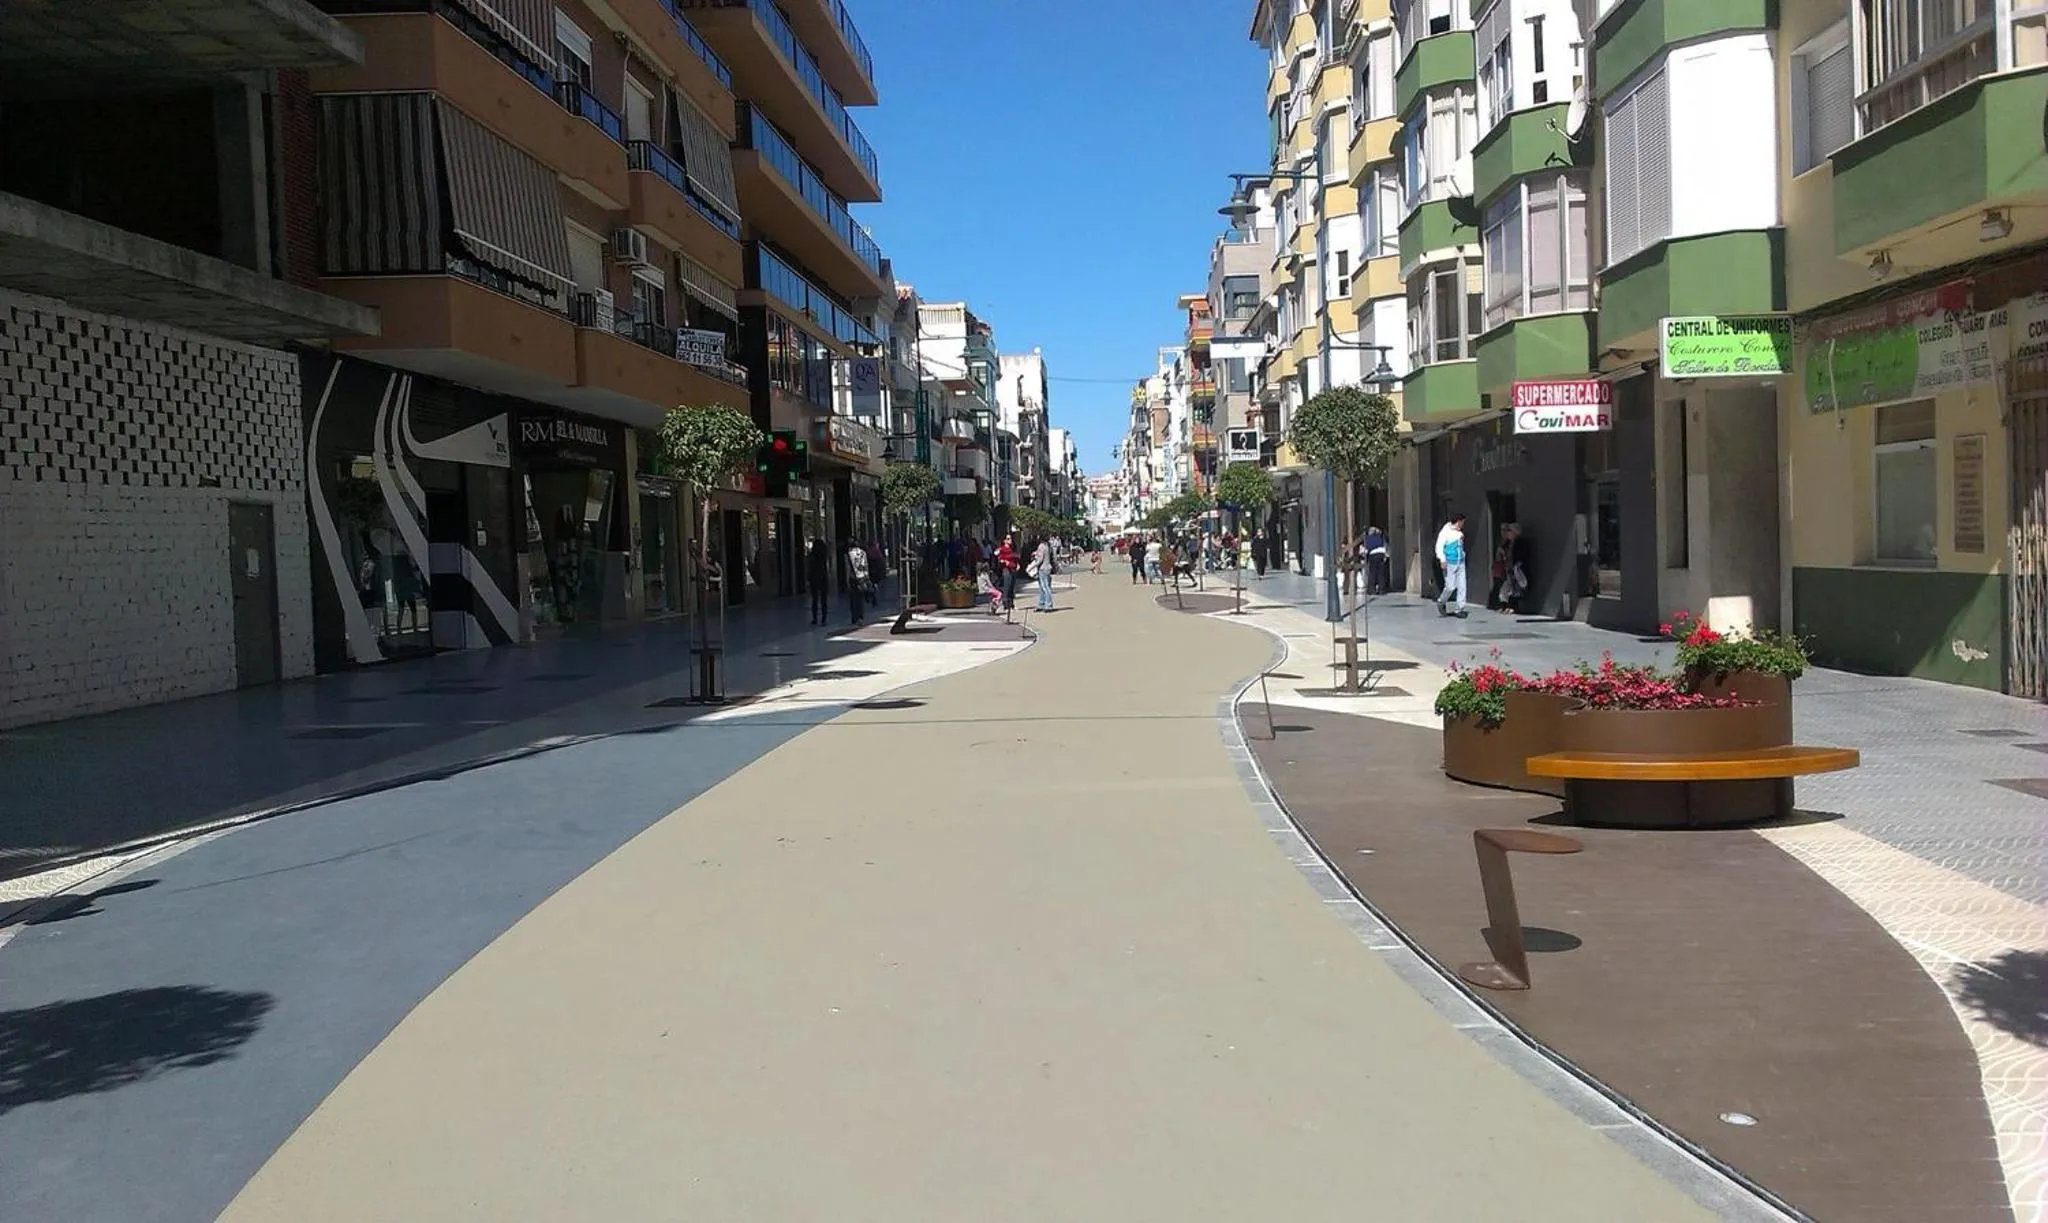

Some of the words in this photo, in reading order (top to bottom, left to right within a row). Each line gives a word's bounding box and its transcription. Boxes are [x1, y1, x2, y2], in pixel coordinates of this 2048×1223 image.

[1667, 321, 1714, 337] CENTRAL
[1716, 319, 1730, 335] DE
[1732, 318, 1790, 334] UNIFORMES
[1919, 323, 1954, 344] COLEGIOS
[678, 340, 722, 354] ALQUILA
[1517, 383, 1609, 406] SUPERMERCADO
